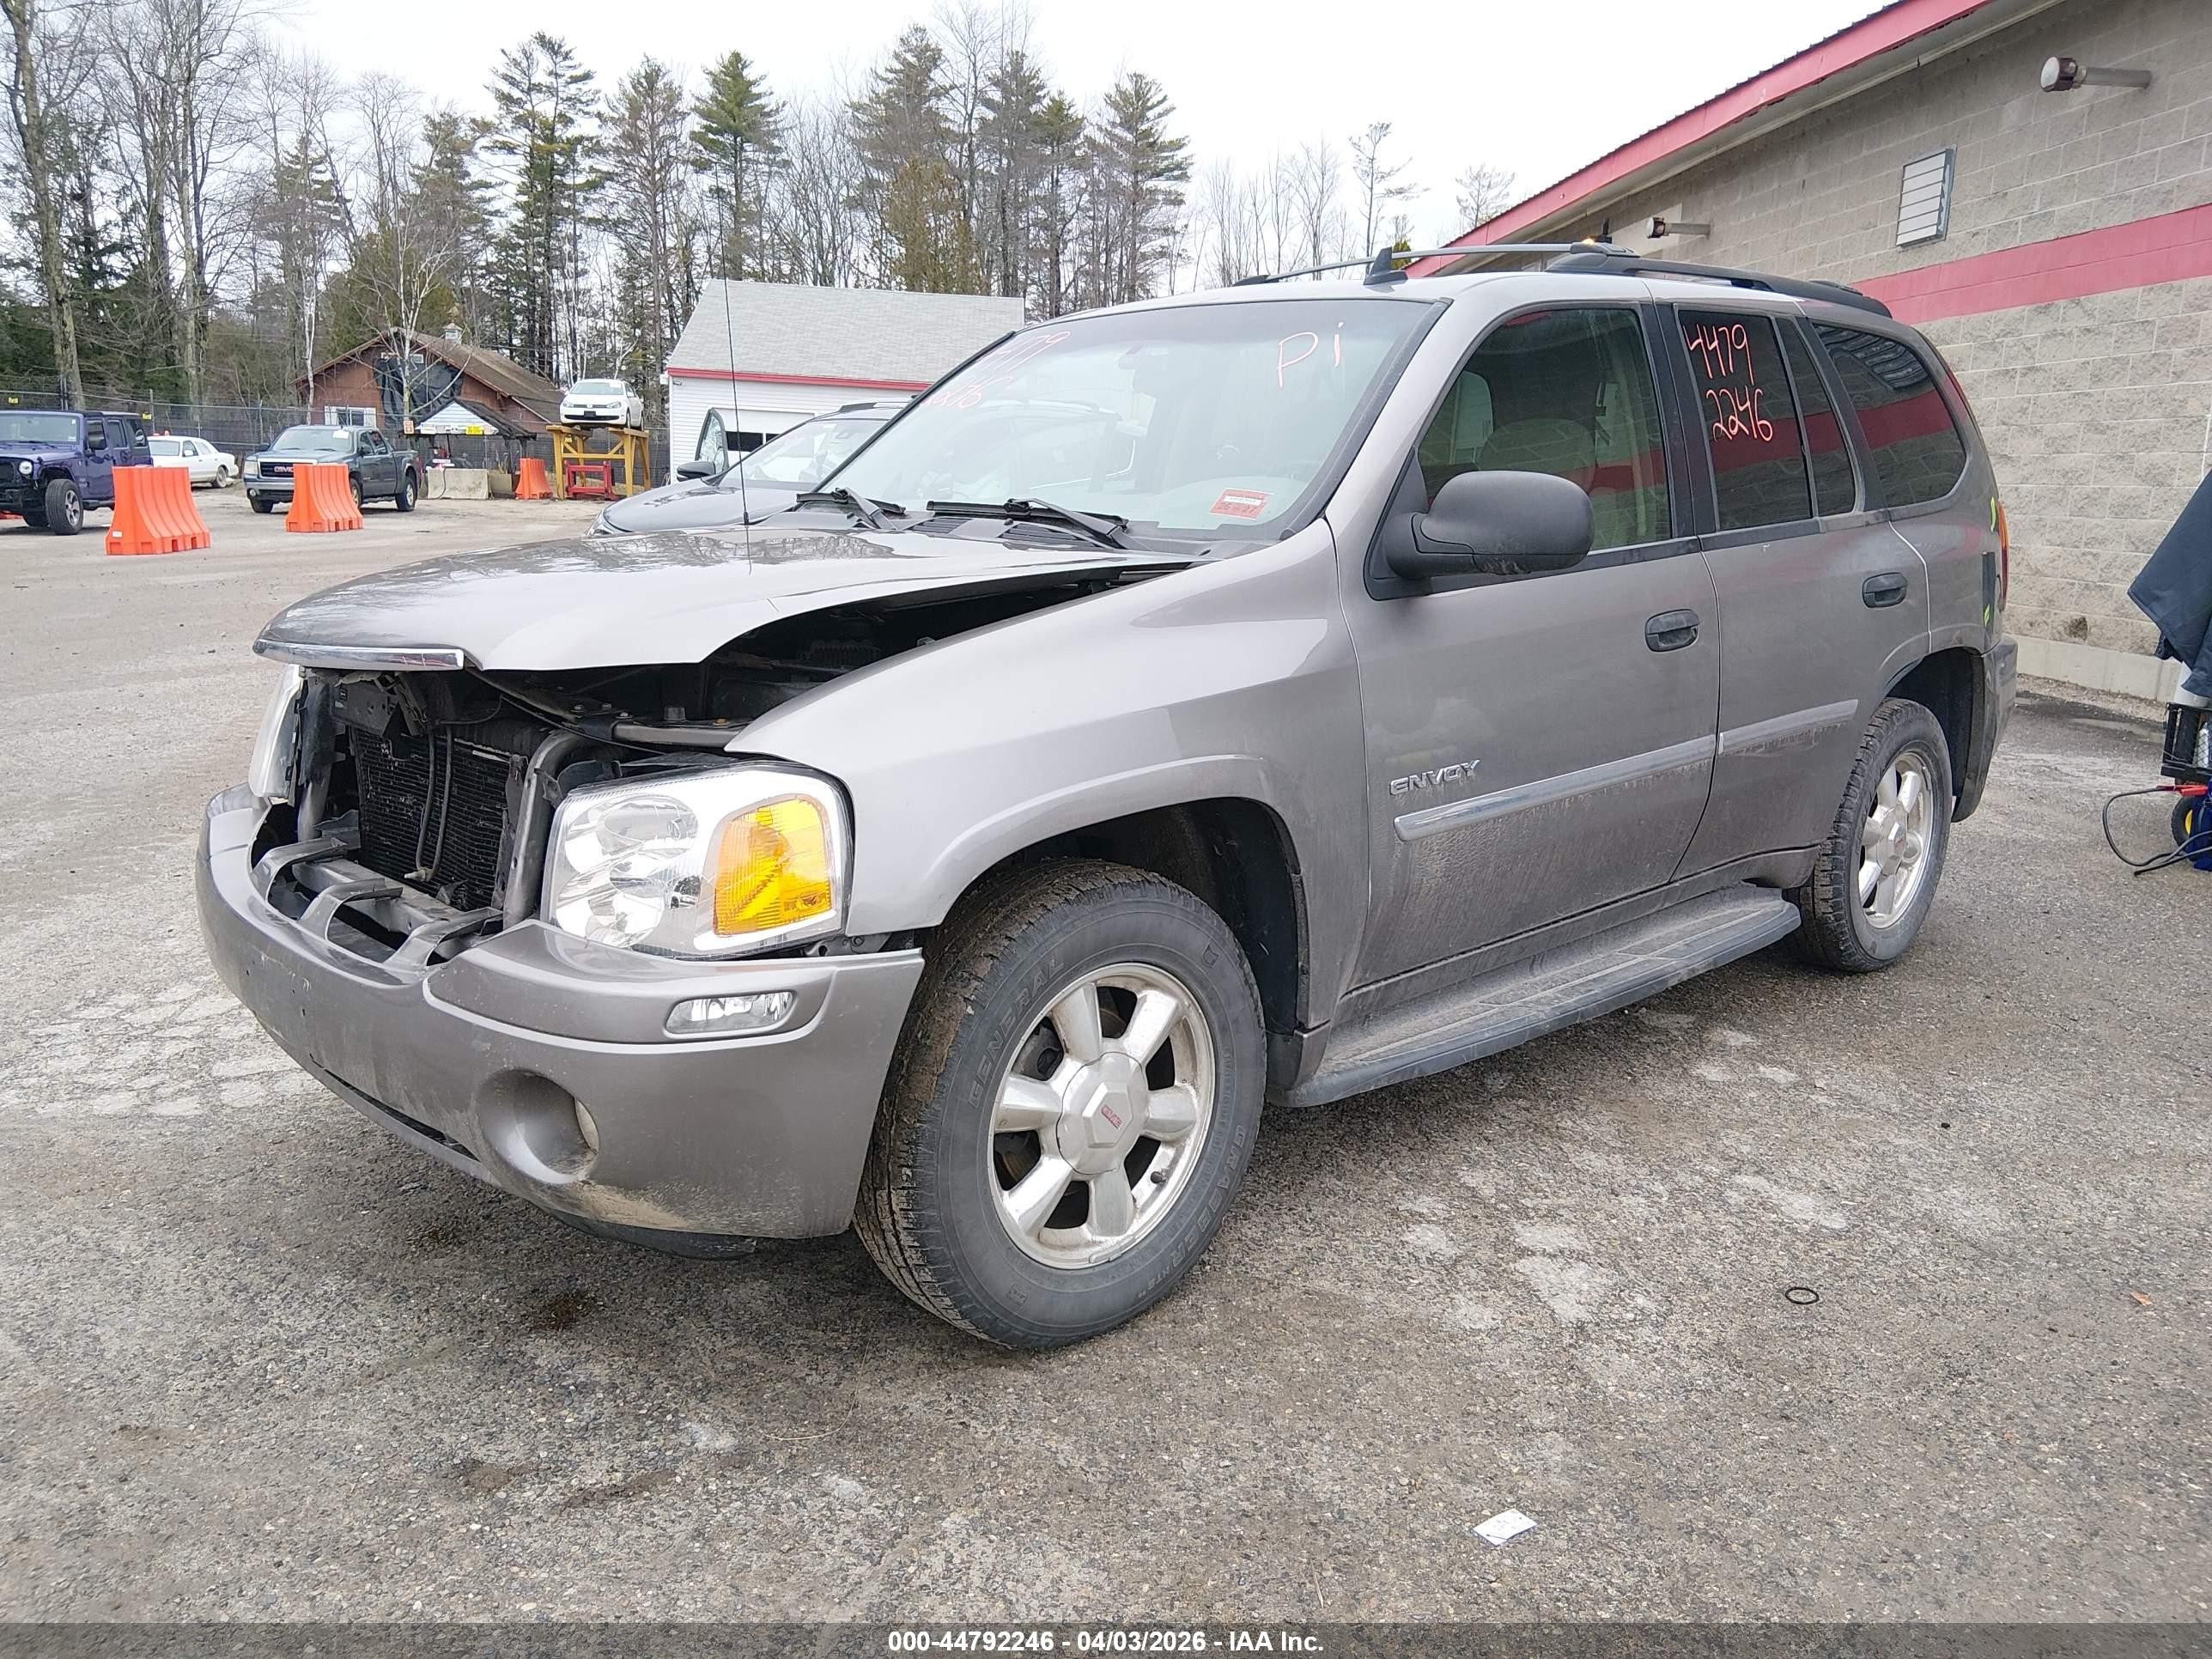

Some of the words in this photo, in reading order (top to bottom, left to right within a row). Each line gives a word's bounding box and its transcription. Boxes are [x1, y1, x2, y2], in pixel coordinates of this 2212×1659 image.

[1682, 324, 1754, 386] 4479
[1705, 385, 1773, 442] 2246
[1389, 759, 1480, 795] ENVOY
[967, 954, 1065, 1109] GENERAL
[1101, 1104, 1123, 1129] GMC
